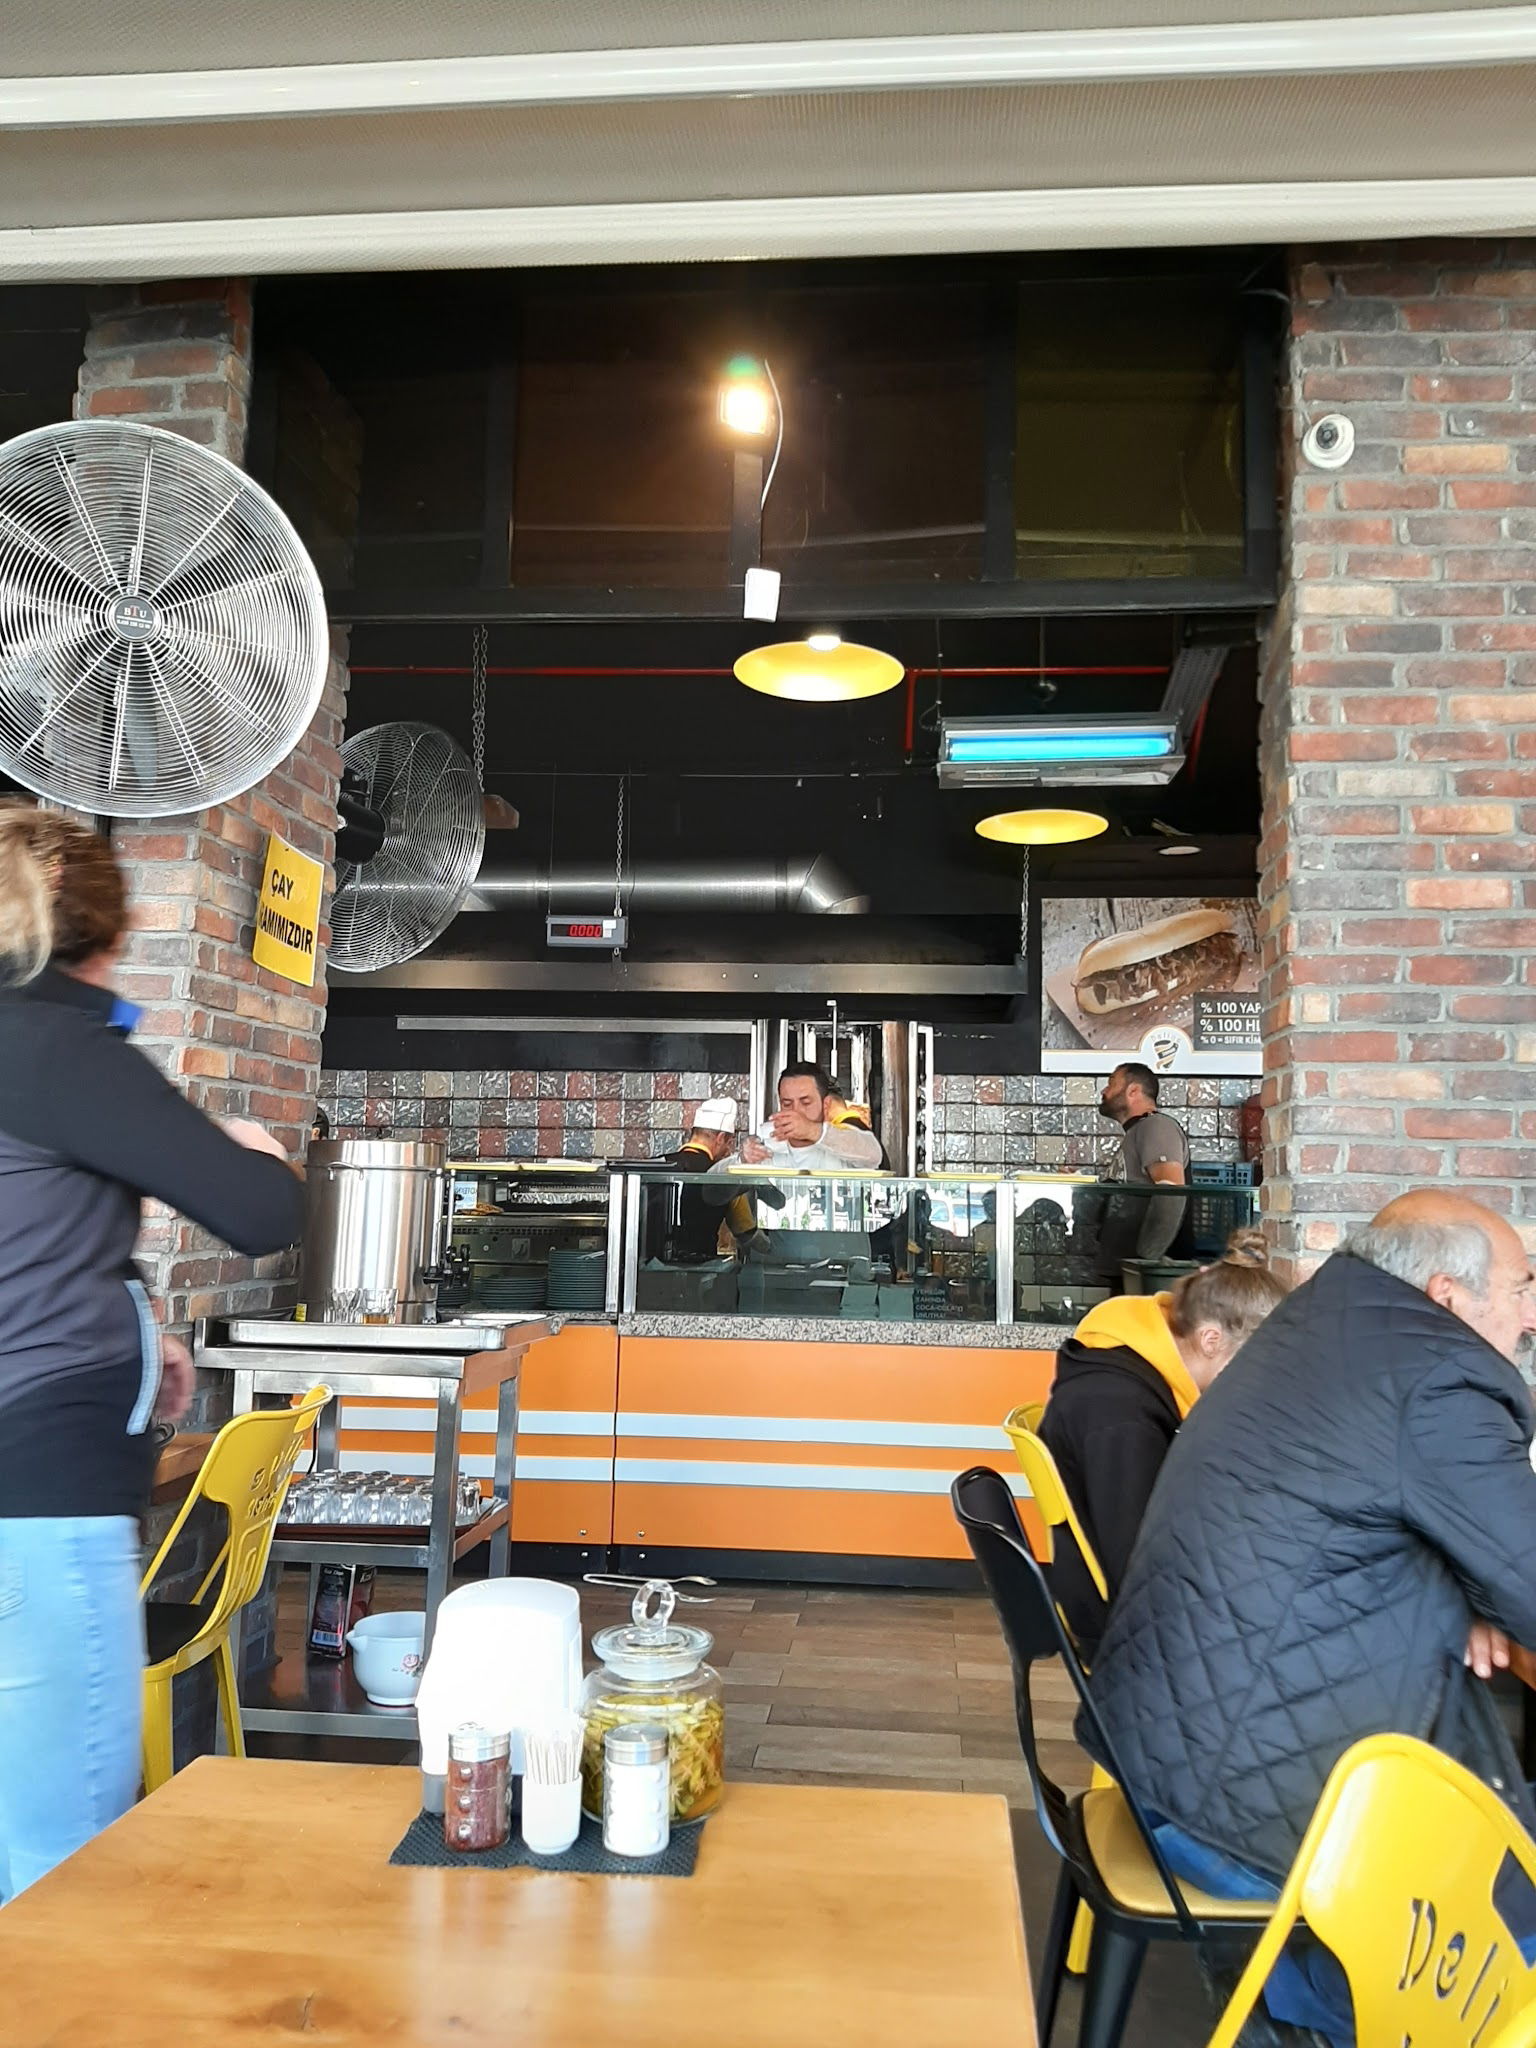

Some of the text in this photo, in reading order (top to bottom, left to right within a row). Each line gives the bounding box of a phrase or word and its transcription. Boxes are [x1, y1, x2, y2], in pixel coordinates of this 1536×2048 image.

[124, 605, 147, 618] BTU
[271, 869, 294, 901] ÇAY
[1200, 1002, 1213, 1014] %
[1216, 1002, 1237, 1014] 100
[1200, 1019, 1213, 1031] %
[1217, 1019, 1242, 1032] 100
